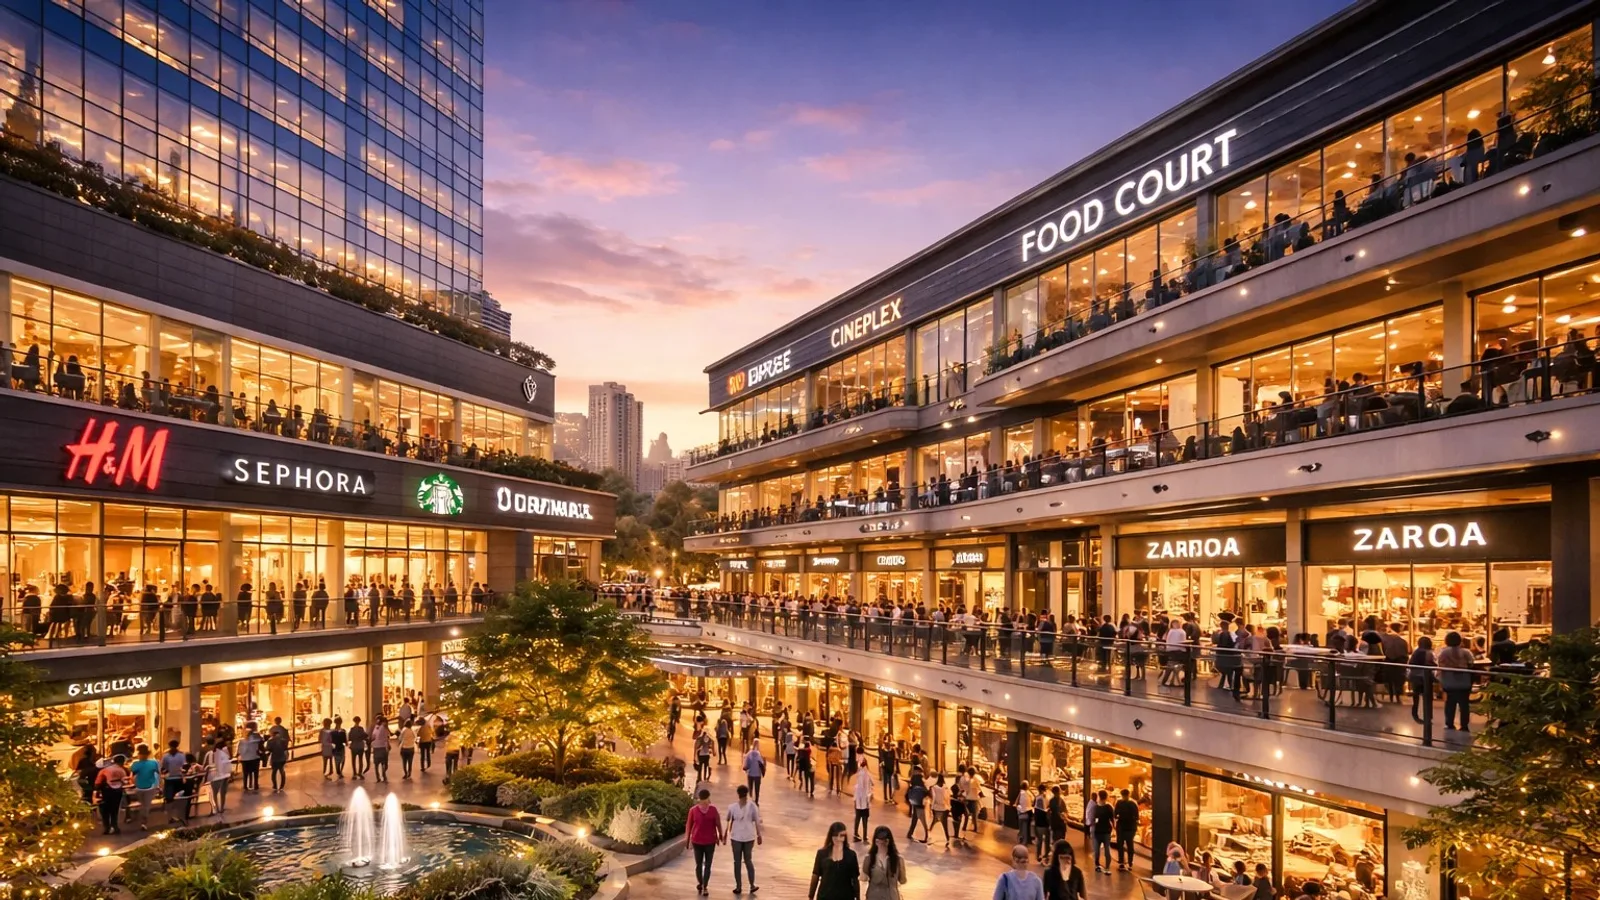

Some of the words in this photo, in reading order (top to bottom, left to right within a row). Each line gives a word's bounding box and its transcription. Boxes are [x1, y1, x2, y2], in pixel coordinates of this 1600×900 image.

[1021, 198, 1104, 262] FOOD
[1114, 128, 1238, 216] COURT
[830, 296, 903, 350] CINEPLEX
[65, 417, 170, 491] H&M
[234, 457, 367, 496] SEPHORA
